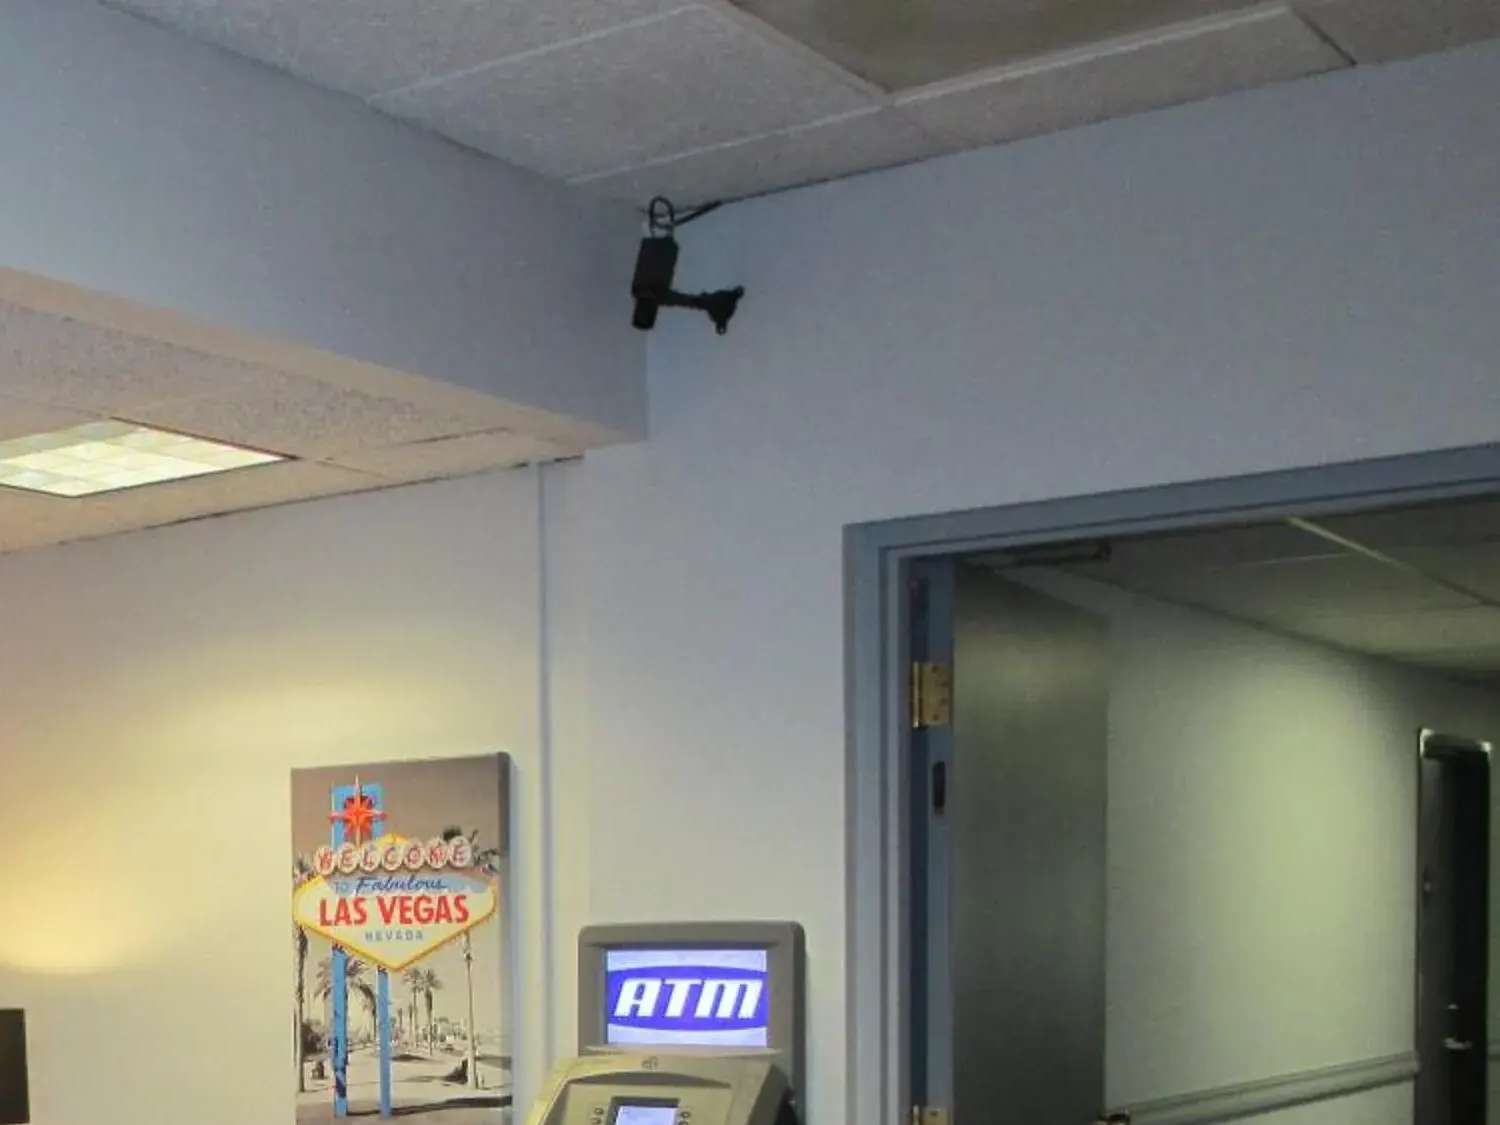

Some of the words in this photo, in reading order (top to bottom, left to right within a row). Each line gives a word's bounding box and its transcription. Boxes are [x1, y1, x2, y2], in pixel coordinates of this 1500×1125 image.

[317, 839, 471, 874] WELCOME
[334, 881, 349, 893] TO
[356, 874, 448, 895] Fabulous
[319, 897, 368, 927] LAS
[376, 894, 470, 926] VEGAS
[365, 930, 424, 942] NEVADA
[613, 977, 764, 1019] ATM
